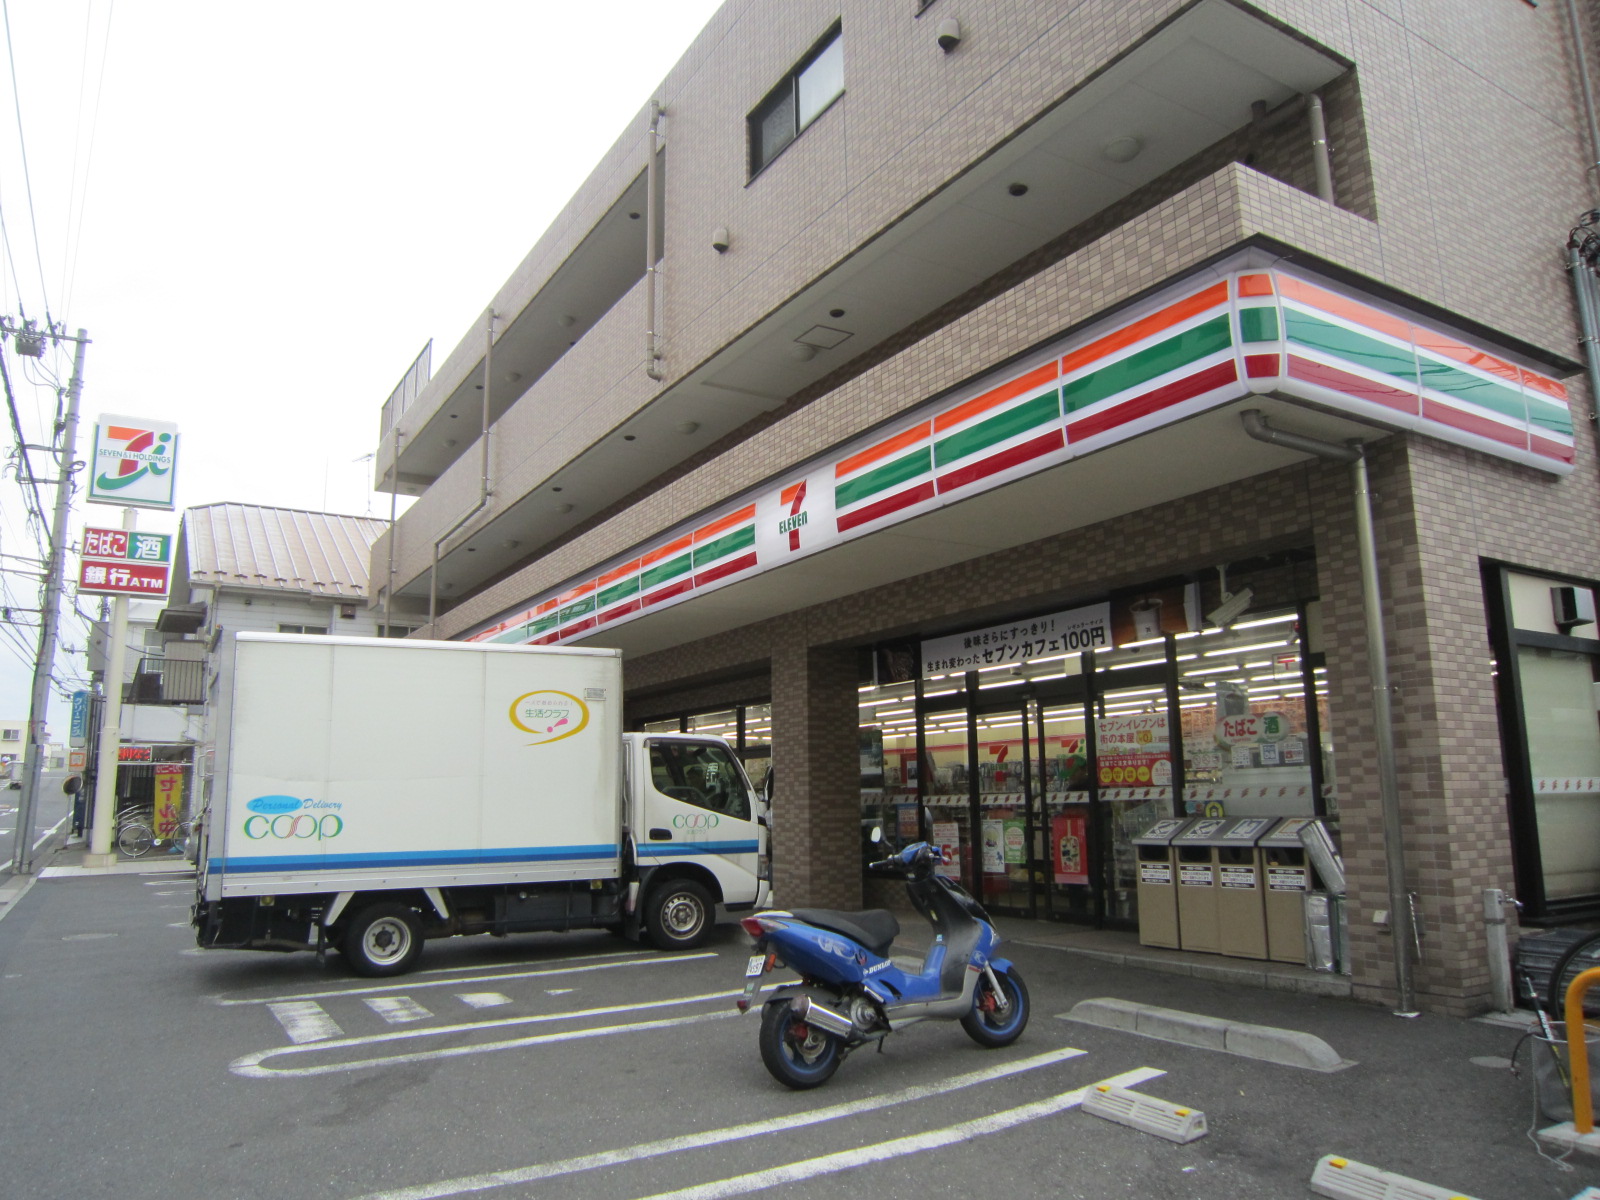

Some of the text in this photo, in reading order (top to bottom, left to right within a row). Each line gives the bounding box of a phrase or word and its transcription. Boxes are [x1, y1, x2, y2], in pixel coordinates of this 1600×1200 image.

[133, 452, 171, 463] HOLDINGS
[779, 510, 808, 535] ELEVEN
[780, 479, 807, 552] 7
[84, 531, 127, 556] たばこ
[135, 535, 163, 559] 酒
[1223, 718, 1258, 737] たばこ
[1263, 715, 1280, 734] 酒
[1100, 733, 1135, 744] 街の本屋
[159, 776, 178, 838] セール中
[252, 798, 343, 811] Personal Delivery
[868, 959, 892, 975] DUNLOP
